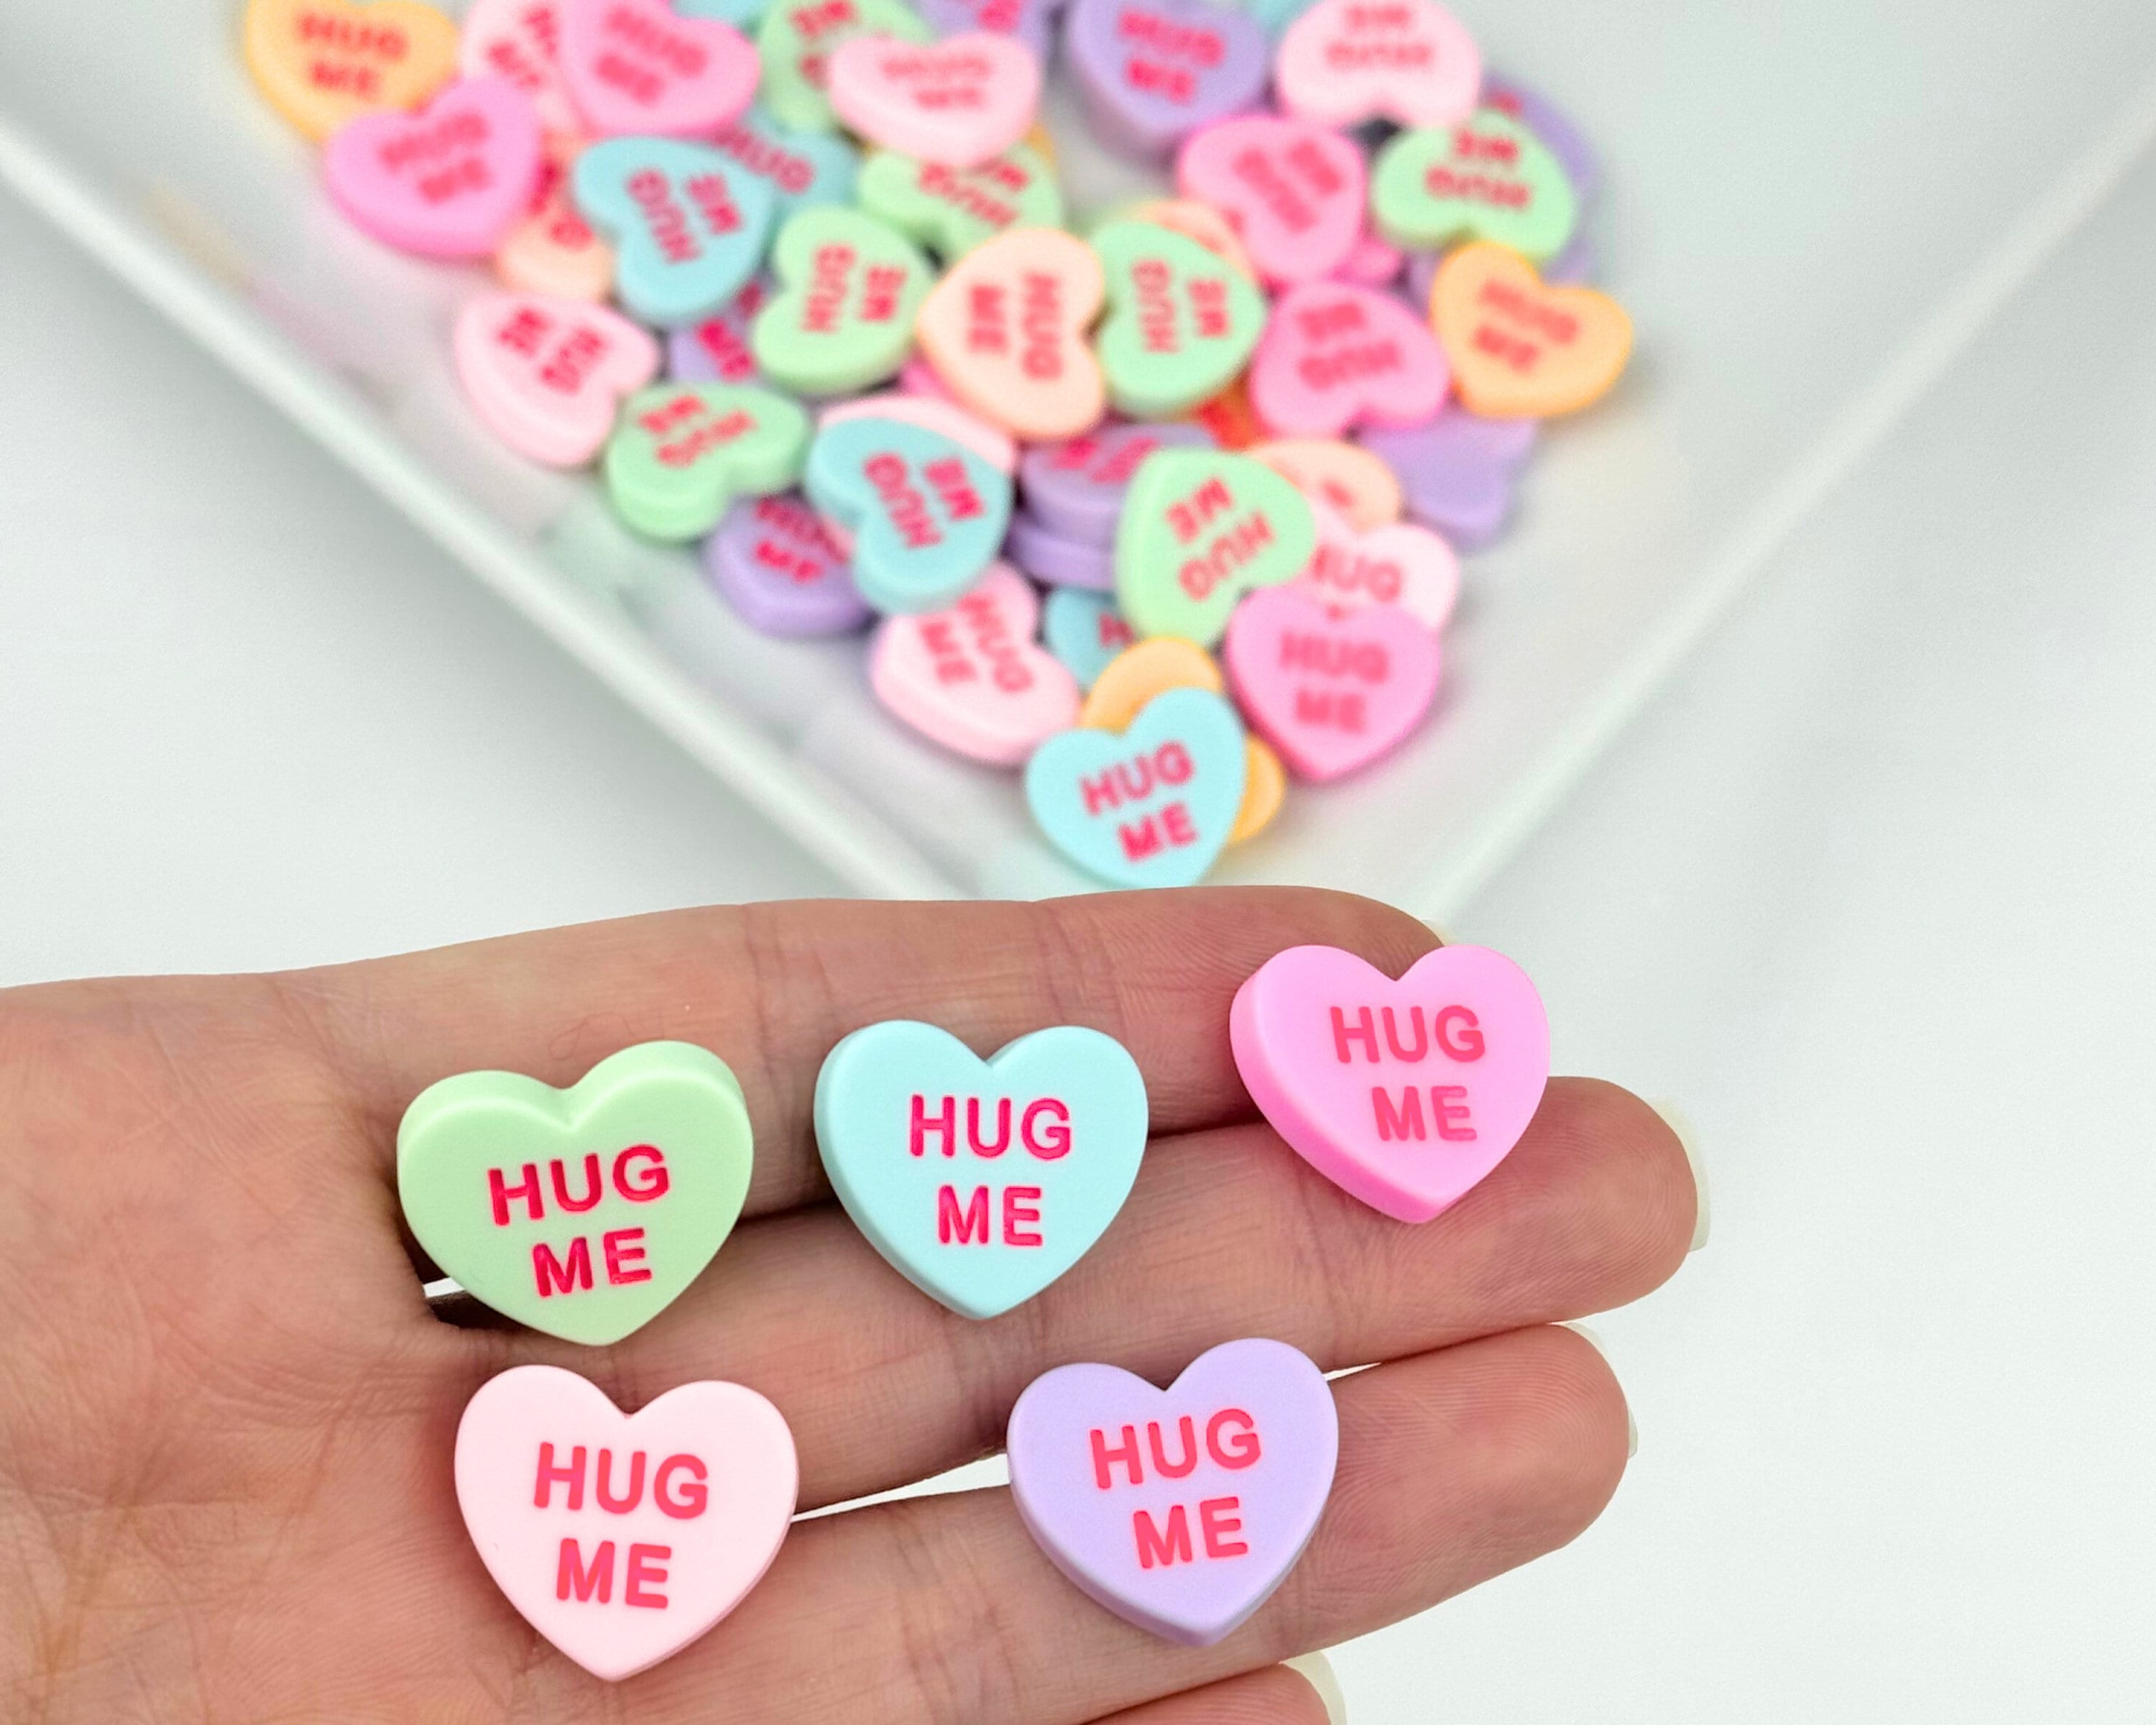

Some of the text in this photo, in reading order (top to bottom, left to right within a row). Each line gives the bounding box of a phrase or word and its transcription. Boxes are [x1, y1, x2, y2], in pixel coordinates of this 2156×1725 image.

[626, 167, 703, 264] HUG
[685, 172, 744, 236] ME
[803, 244, 856, 332] HUG
[860, 267, 907, 322] ME
[969, 285, 1008, 354] ME
[1023, 271, 1062, 381] HUG
[863, 453, 944, 549] HUG
[923, 458, 985, 523] ME
[1166, 477, 1234, 544] ME
[1177, 512, 1273, 603] HUG
[918, 620, 977, 686] ME
[959, 591, 1033, 694] HUG
[1276, 632, 1390, 686] HUG
[1294, 690, 1365, 734] ME
[1079, 740, 1194, 818] HUG
[1118, 801, 1198, 864] ME
[1329, 1005, 1486, 1065] HUG
[909, 1094, 1071, 1162] HUG
[1370, 1085, 1478, 1142] ME
[488, 1144, 670, 1226] HUG
[937, 1184, 1044, 1247] ME
[531, 1228, 652, 1298] ME
[532, 1440, 709, 1520] HUG
[1089, 1407, 1262, 1491] HUG
[1132, 1496, 1249, 1570] ME
[556, 1537, 672, 1610] ME
